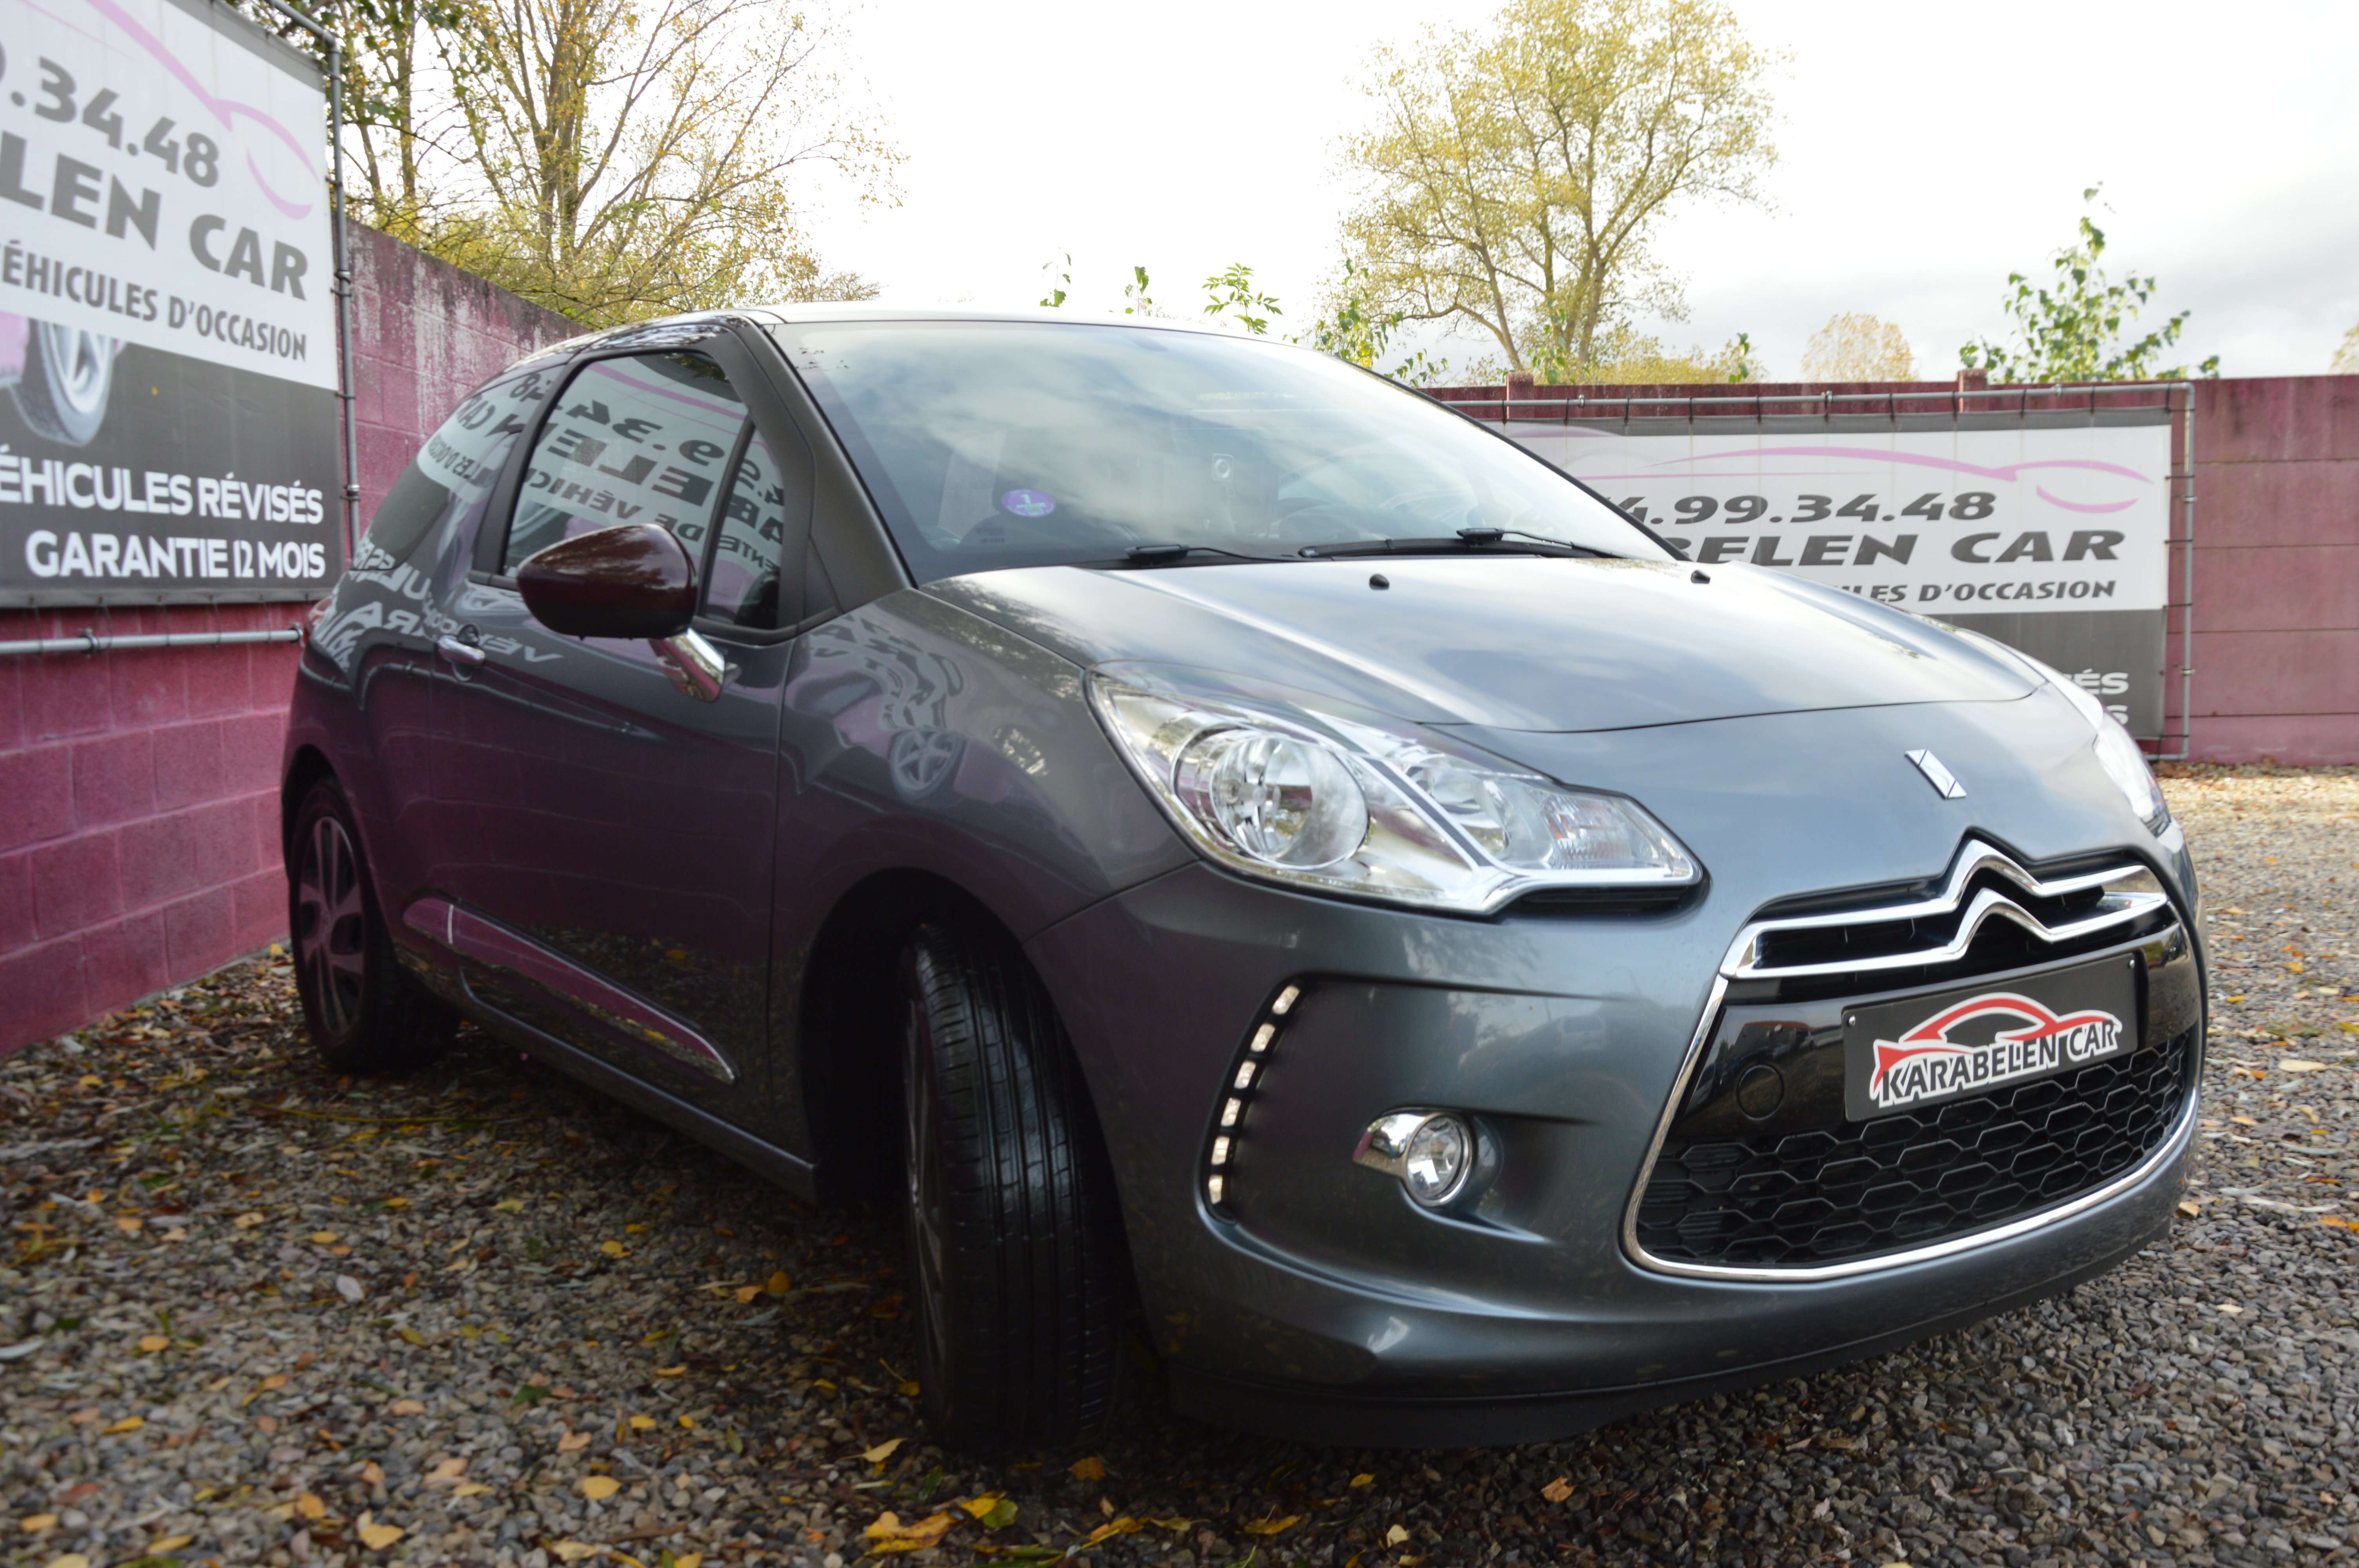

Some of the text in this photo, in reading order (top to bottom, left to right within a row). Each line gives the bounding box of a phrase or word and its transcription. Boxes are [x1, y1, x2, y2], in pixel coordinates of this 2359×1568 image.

[0, 40, 219, 188] .34.48
[0, 130, 309, 301] LEN CAR
[0, 239, 307, 361] ÉHICULES D'OCCASION
[0, 443, 324, 524] ÉHICULES RÉVISÉS
[1607, 491, 1996, 524] 4.99.34.48
[25, 530, 325, 578] GARANTIE 12 MOIS
[1951, 530, 2125, 563] CAR
[1918, 580, 2115, 602] D'OCCASION
[2063, 668, 2129, 695] ÉS
[1882, 1020, 2117, 1102] KARABELEN CAR
